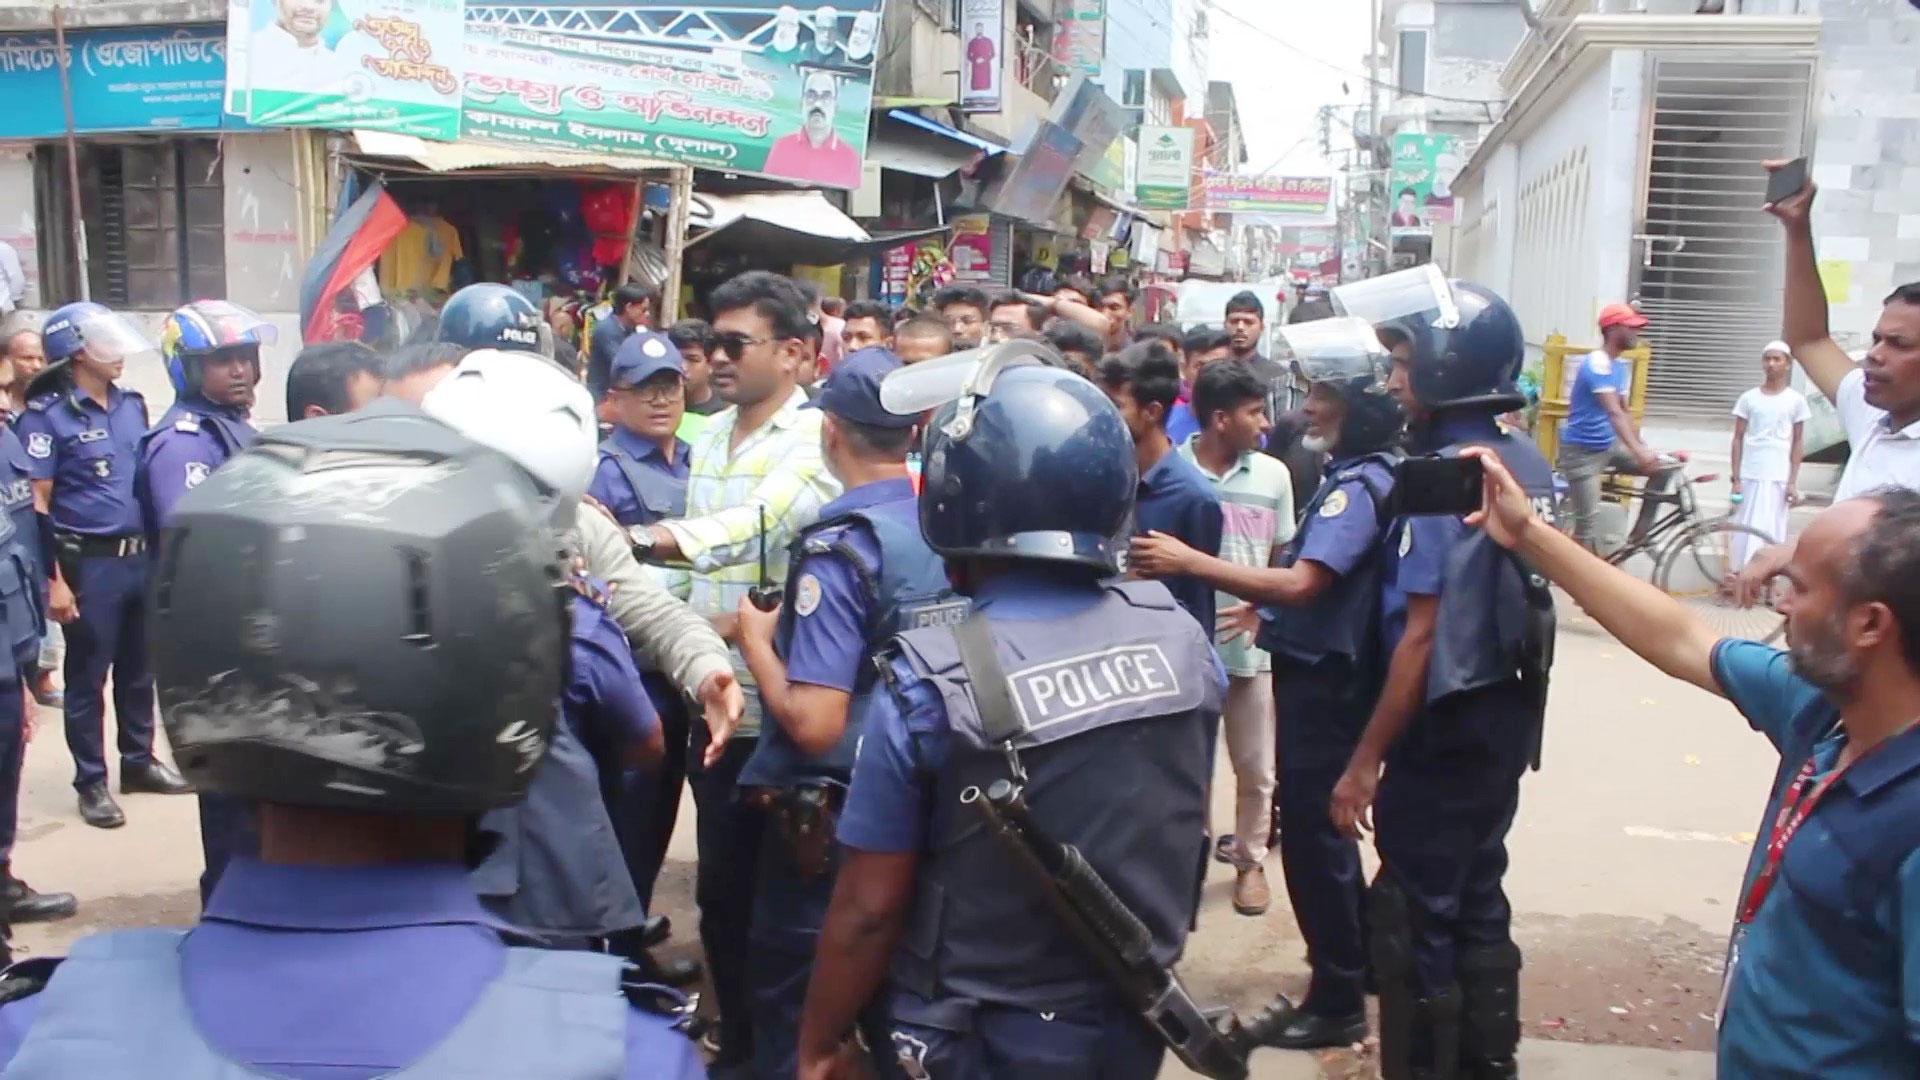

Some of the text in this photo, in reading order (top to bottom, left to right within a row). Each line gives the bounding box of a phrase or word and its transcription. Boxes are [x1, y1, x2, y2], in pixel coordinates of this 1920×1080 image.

[577, 83, 604, 108] ও
[567, 121, 648, 146] ইসলাম
[503, 328, 537, 344] POLICE
[1027, 653, 1165, 717] POLICE
